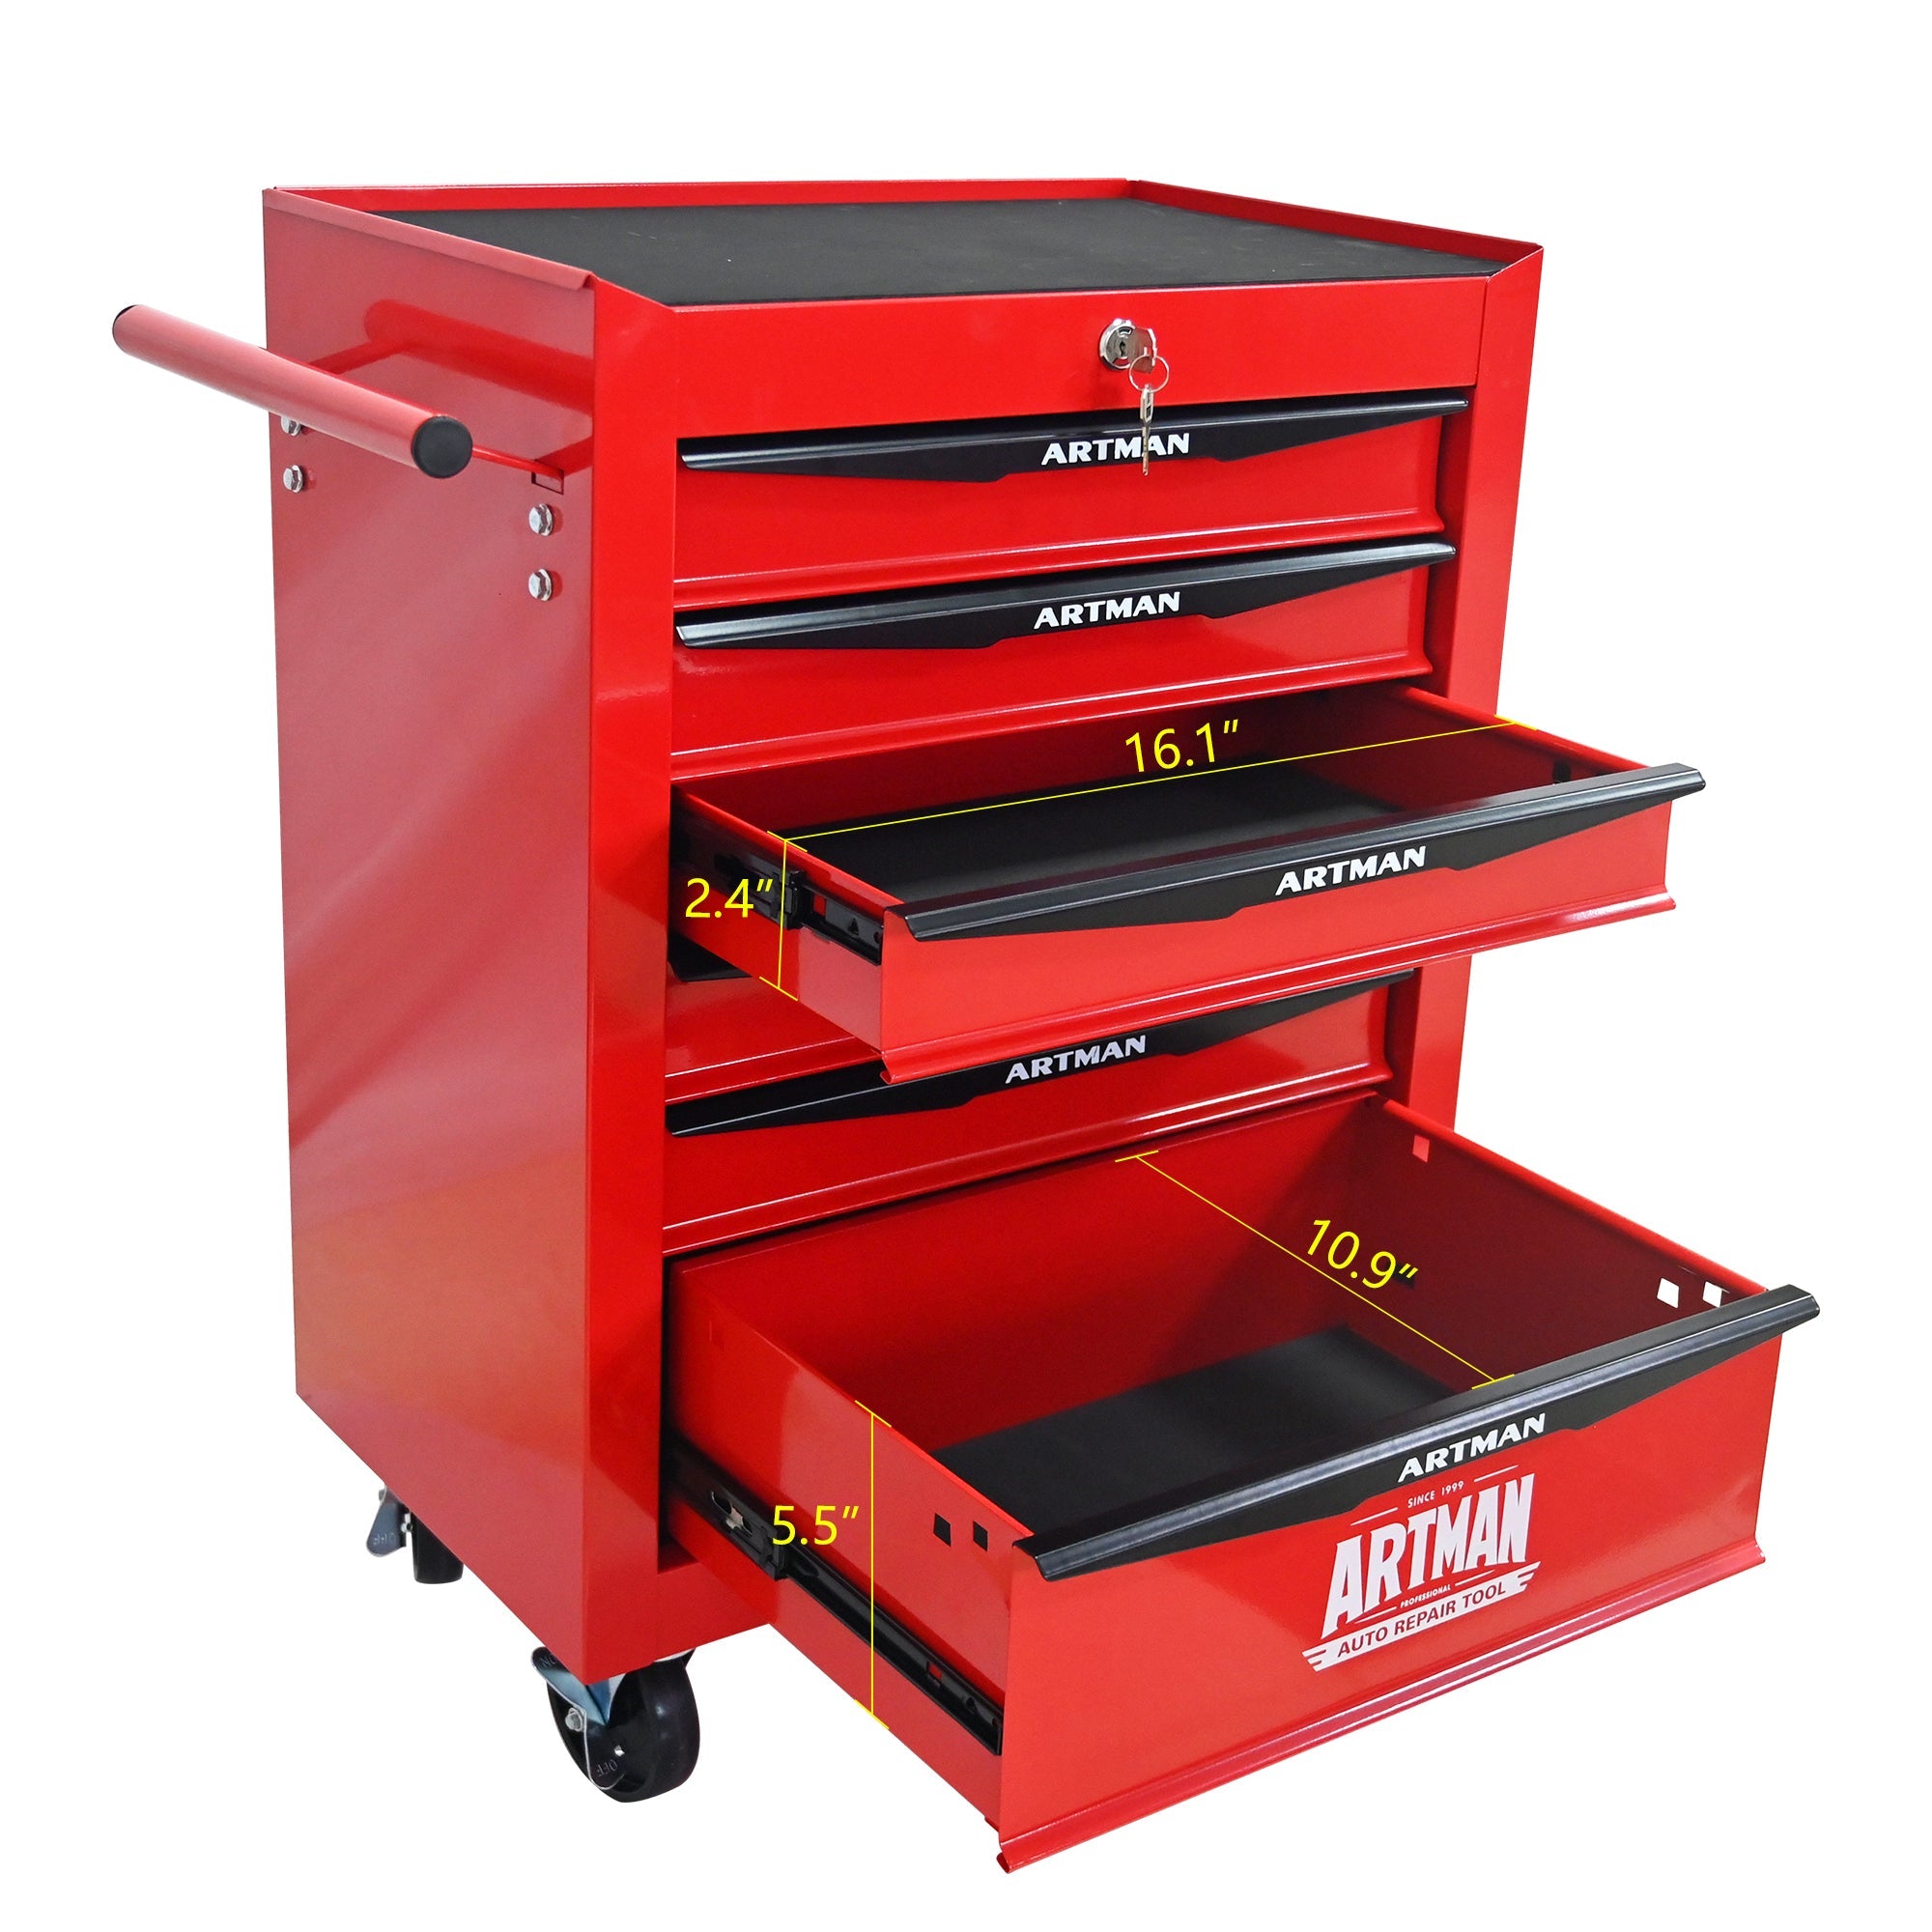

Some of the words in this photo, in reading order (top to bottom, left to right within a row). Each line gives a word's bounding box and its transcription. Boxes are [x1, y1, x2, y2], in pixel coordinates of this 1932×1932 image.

[1040, 432, 1190, 466] ARTMAN
[1034, 591, 1180, 630] ARTMAN
[1275, 845, 1427, 896] ARTMAN
[1005, 1035, 1146, 1084] ARTMAN
[1397, 1412, 1546, 1483] ARTMAN
[1406, 1490, 1435, 1509] SINCE
[1441, 1480, 1464, 1496] 1999
[1321, 1472, 1536, 1640] ARTMAN
[1400, 1583, 1451, 1608] PROFESSIONAL
[1337, 1626, 1388, 1658] AUTO
[1394, 1600, 1456, 1635] REPAIR
[1462, 1581, 1507, 1608] TOOL
[596, 1759, 618, 1777] OFF
